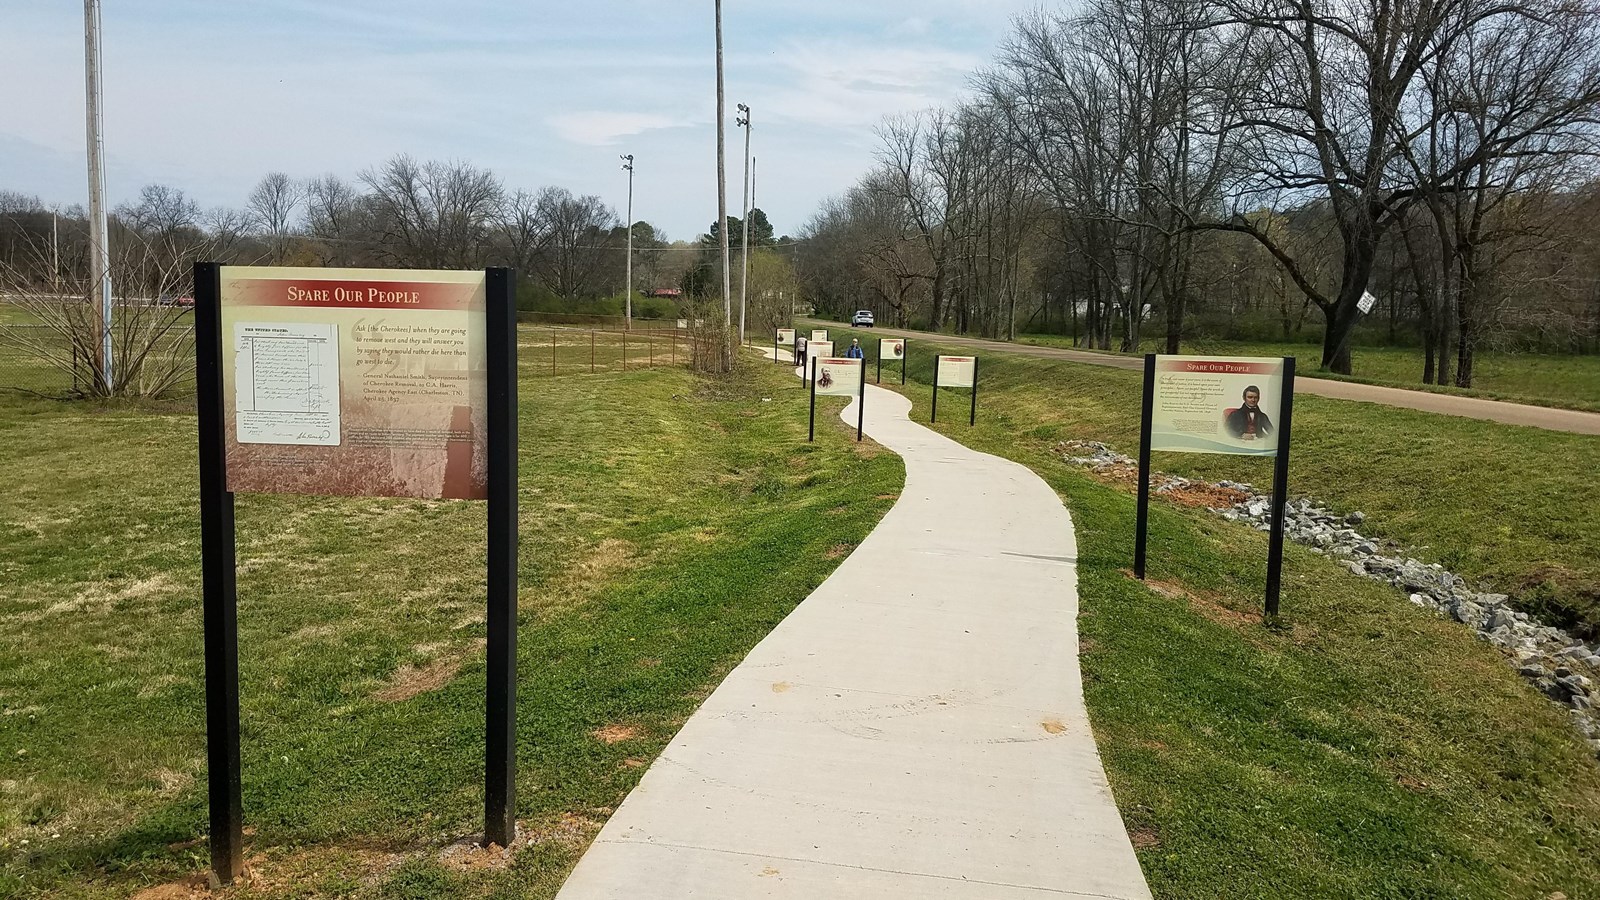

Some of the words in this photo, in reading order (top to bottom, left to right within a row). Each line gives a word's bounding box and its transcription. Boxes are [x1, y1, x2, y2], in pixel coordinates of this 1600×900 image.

[288, 286, 330, 301] SPARE
[334, 287, 363, 302] OUR
[368, 288, 420, 303] PEOPLE
[380, 325, 412, 333] Cherokees]
[429, 327, 439, 335] they
